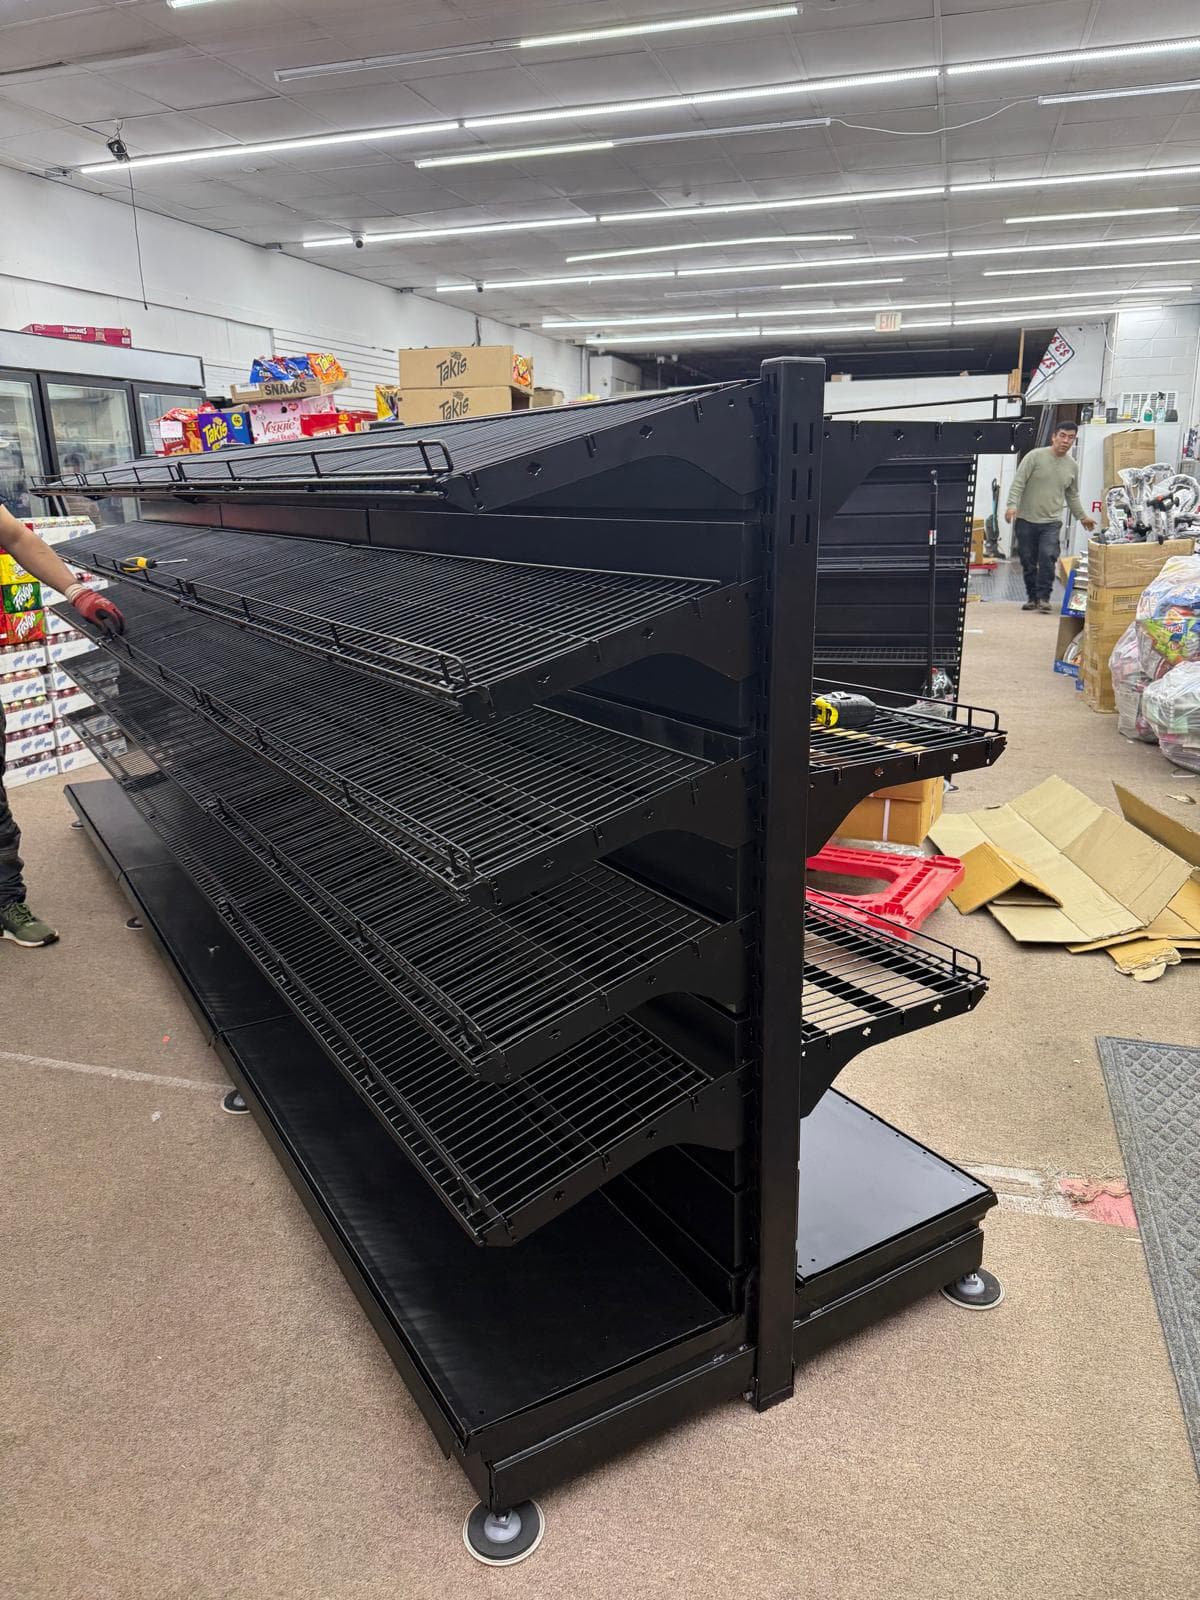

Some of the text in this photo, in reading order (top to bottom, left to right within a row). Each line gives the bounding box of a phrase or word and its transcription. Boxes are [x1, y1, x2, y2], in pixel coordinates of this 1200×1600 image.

[436, 357, 467, 386] Takis
[264, 382, 308, 395] SNACKS
[439, 397, 470, 420] Takis
[203, 422, 228, 447] Takis
[262, 420, 296, 435] Veggie
